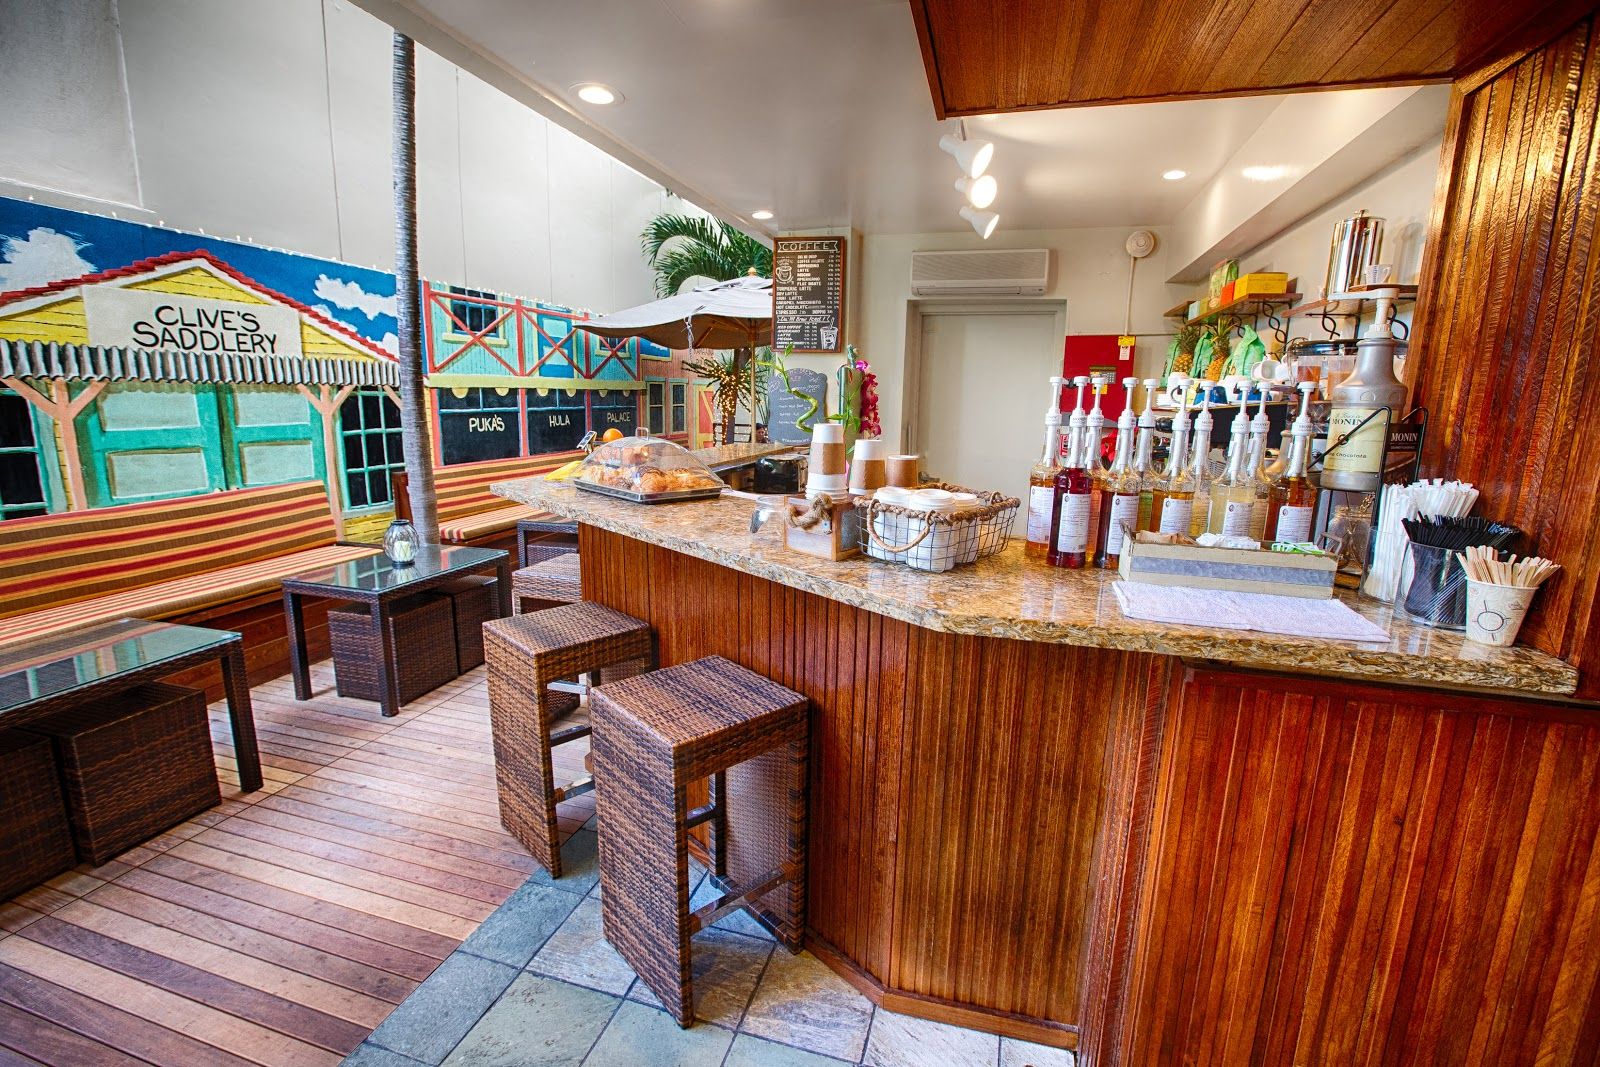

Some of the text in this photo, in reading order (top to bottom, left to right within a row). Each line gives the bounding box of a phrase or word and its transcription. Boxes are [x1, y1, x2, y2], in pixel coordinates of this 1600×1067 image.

[782, 242, 830, 251] COFFEE
[154, 305, 261, 333] CLIVE'S
[132, 321, 277, 354] SADDLERY
[468, 411, 631, 432] PUKA'S HULA PALACE
[1390, 432, 1419, 442] MONIN
